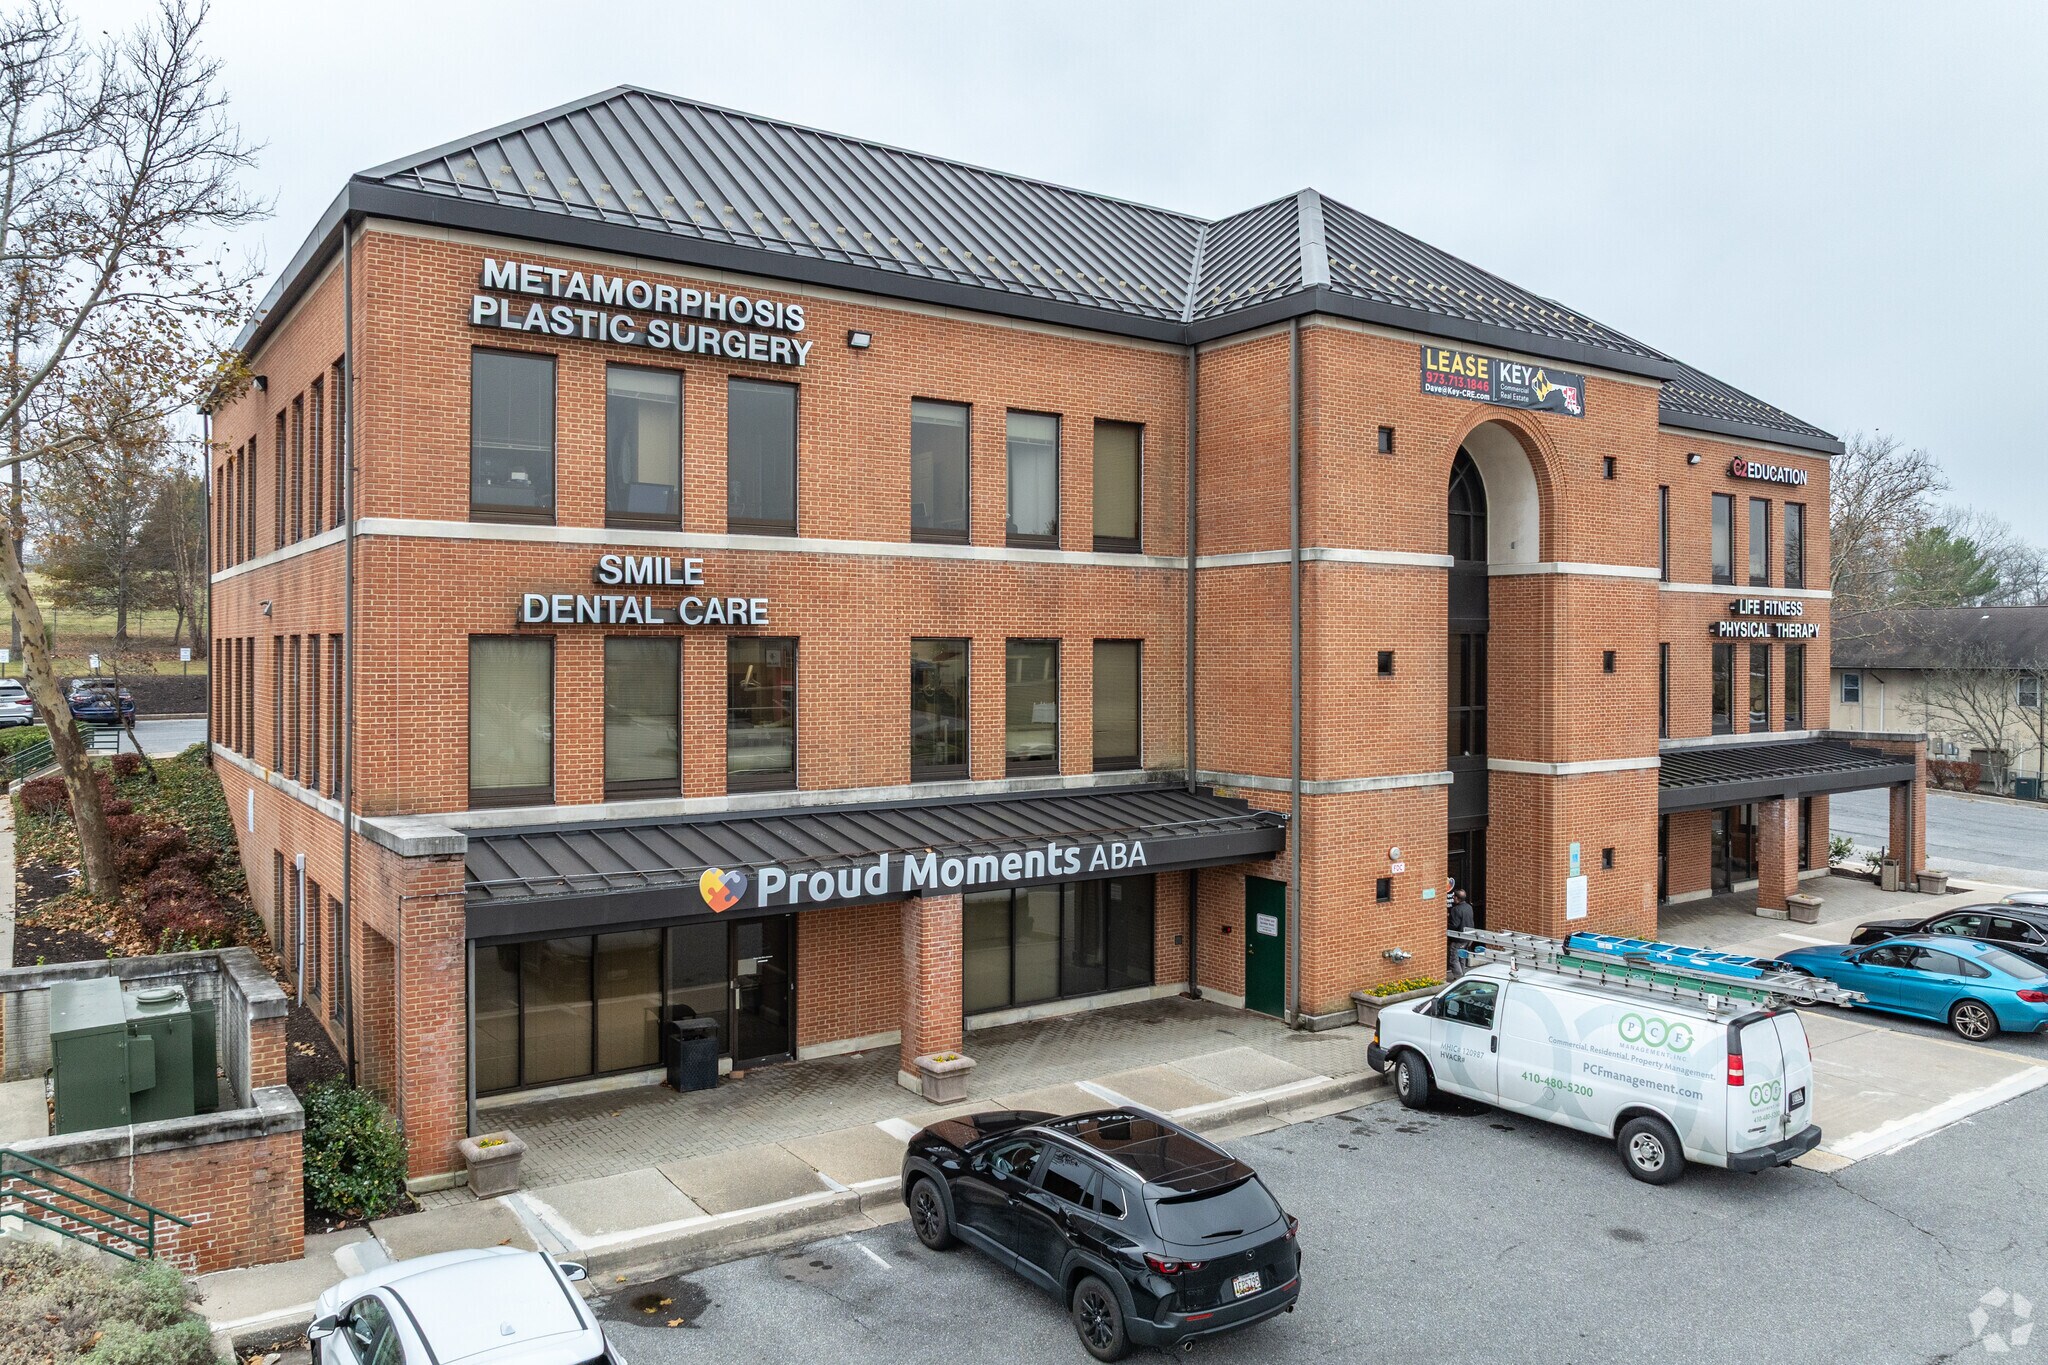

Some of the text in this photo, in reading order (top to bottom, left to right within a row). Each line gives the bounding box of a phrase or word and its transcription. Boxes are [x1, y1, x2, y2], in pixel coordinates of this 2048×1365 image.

[482, 257, 806, 332] METAMORPHOSIS
[472, 294, 813, 367] PLASTIC SURGERY
[1426, 349, 1489, 379] LEASE
[1500, 362, 1533, 386] KEY
[1425, 383, 1490, 401] Dave@Key-CRE.com
[1426, 371, 1490, 392] 973.713.1846
[1500, 383, 1530, 394] Commercial
[1500, 391, 1530, 402] Real Estate
[599, 554, 705, 585] SMILE
[523, 593, 770, 626] DENTAL CARE
[1739, 599, 1803, 616] LIFE FITNESS
[1719, 621, 1820, 638] PHYSICAL THERAPY
[757, 841, 1148, 908] Proud Moments ABA
[1393, 864, 1403, 872] FDC
[1631, 1054, 1663, 1070] Property
[1521, 1071, 1594, 1098] 410-480-5200
[1583, 1062, 1704, 1100] PCFmanagement.com
